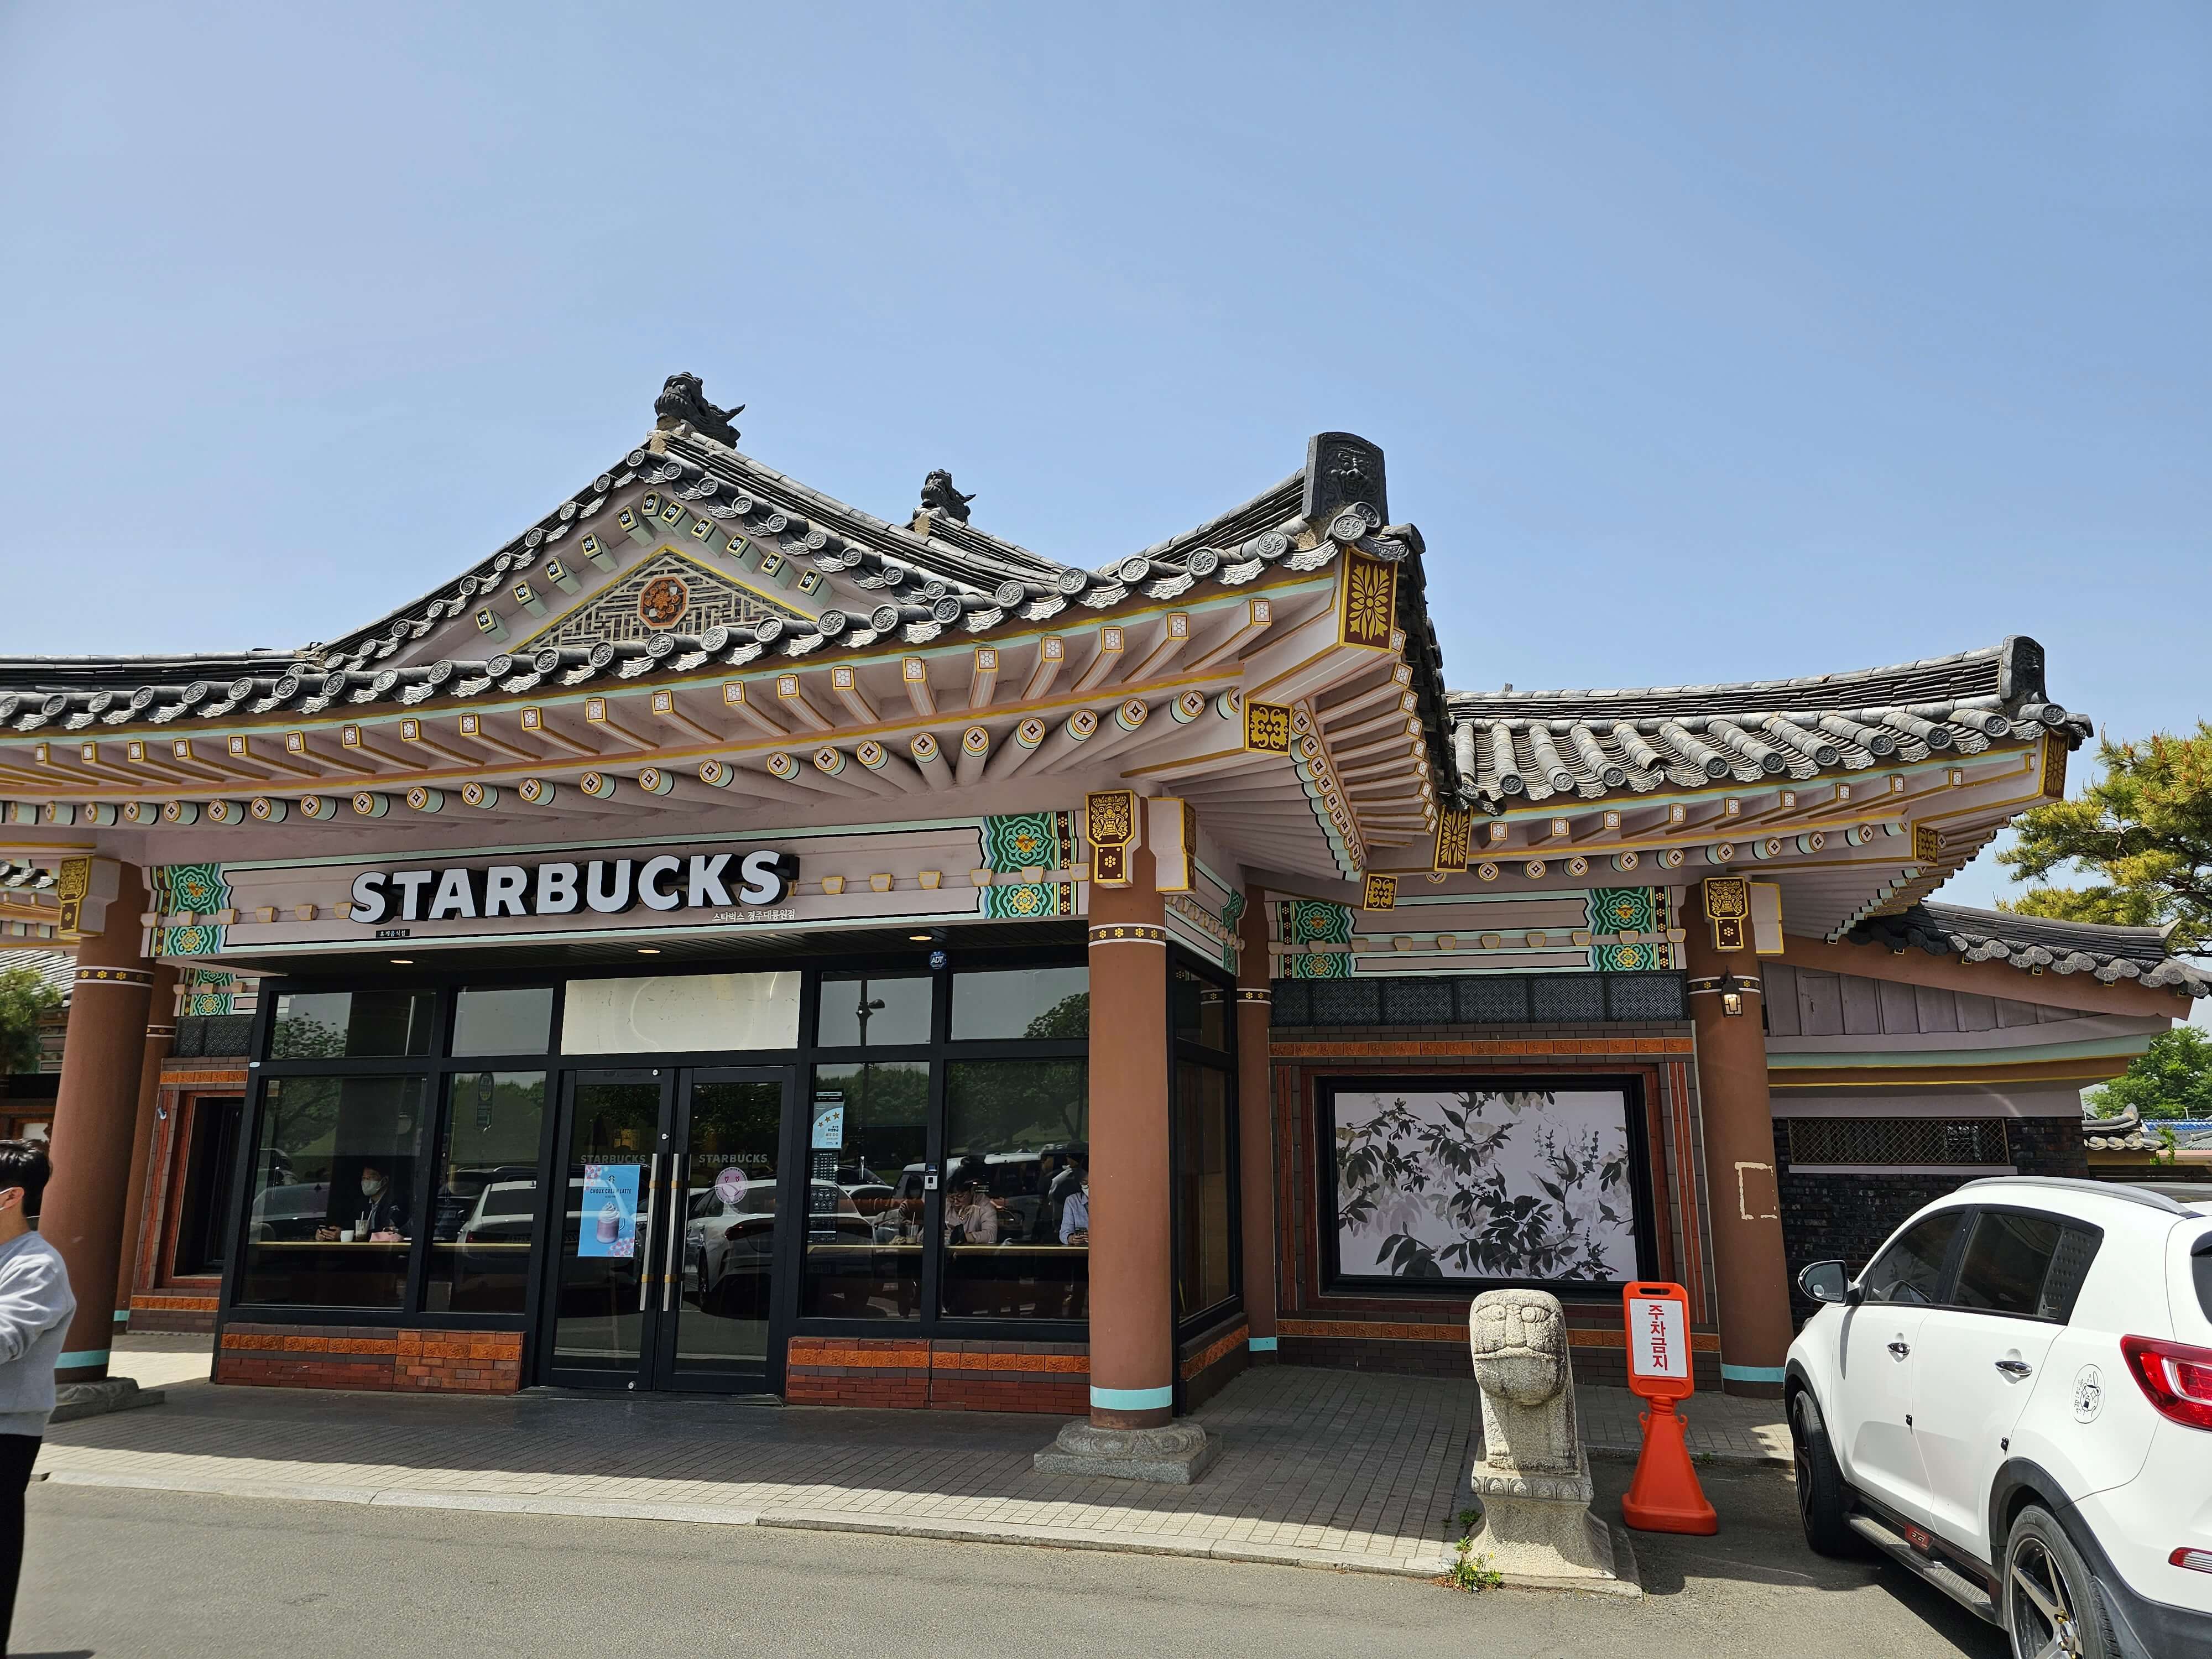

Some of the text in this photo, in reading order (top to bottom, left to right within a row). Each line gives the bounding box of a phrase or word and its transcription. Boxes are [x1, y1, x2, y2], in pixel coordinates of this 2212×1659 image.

[349, 849, 785, 925] STARBUCKS
[712, 909, 796, 922] 스타벅스 경주대릉원점
[580, 1154, 646, 1164] STARBUCKS
[699, 1154, 768, 1163] STARBUCKS
[1648, 1305, 1668, 1371] 주차금지
